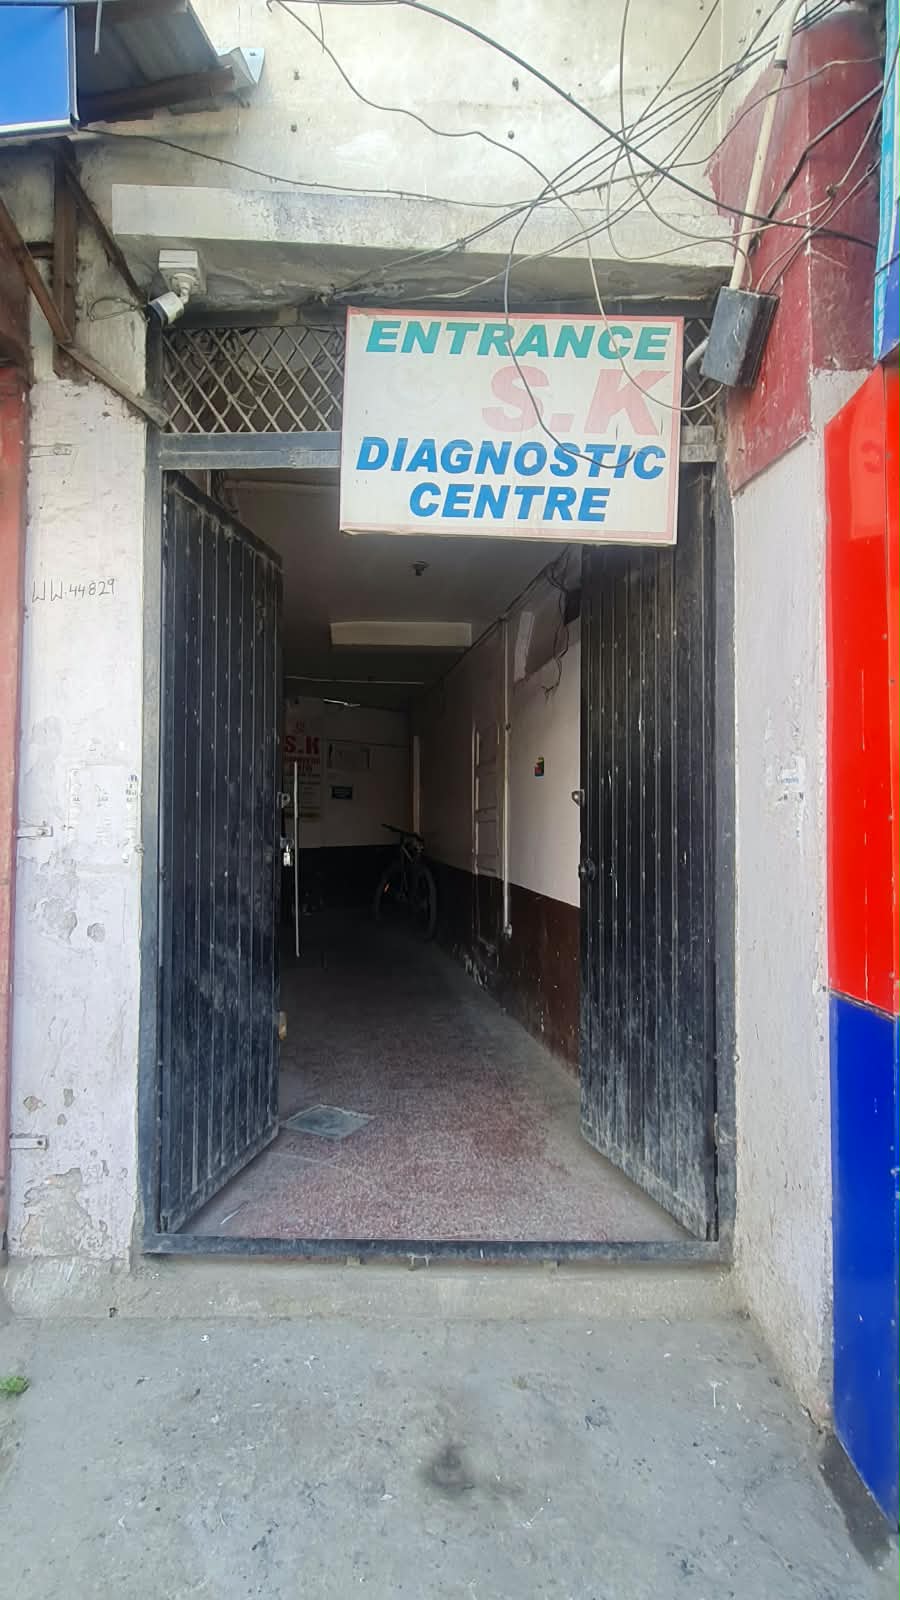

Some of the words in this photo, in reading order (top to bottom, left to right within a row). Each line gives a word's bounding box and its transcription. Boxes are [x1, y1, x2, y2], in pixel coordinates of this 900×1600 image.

[366, 320, 671, 361] ENTRANCE
[482, 365, 670, 436] S.K
[356, 436, 666, 480] DIAGNOSTIC
[409, 482, 610, 522] CENTRE
